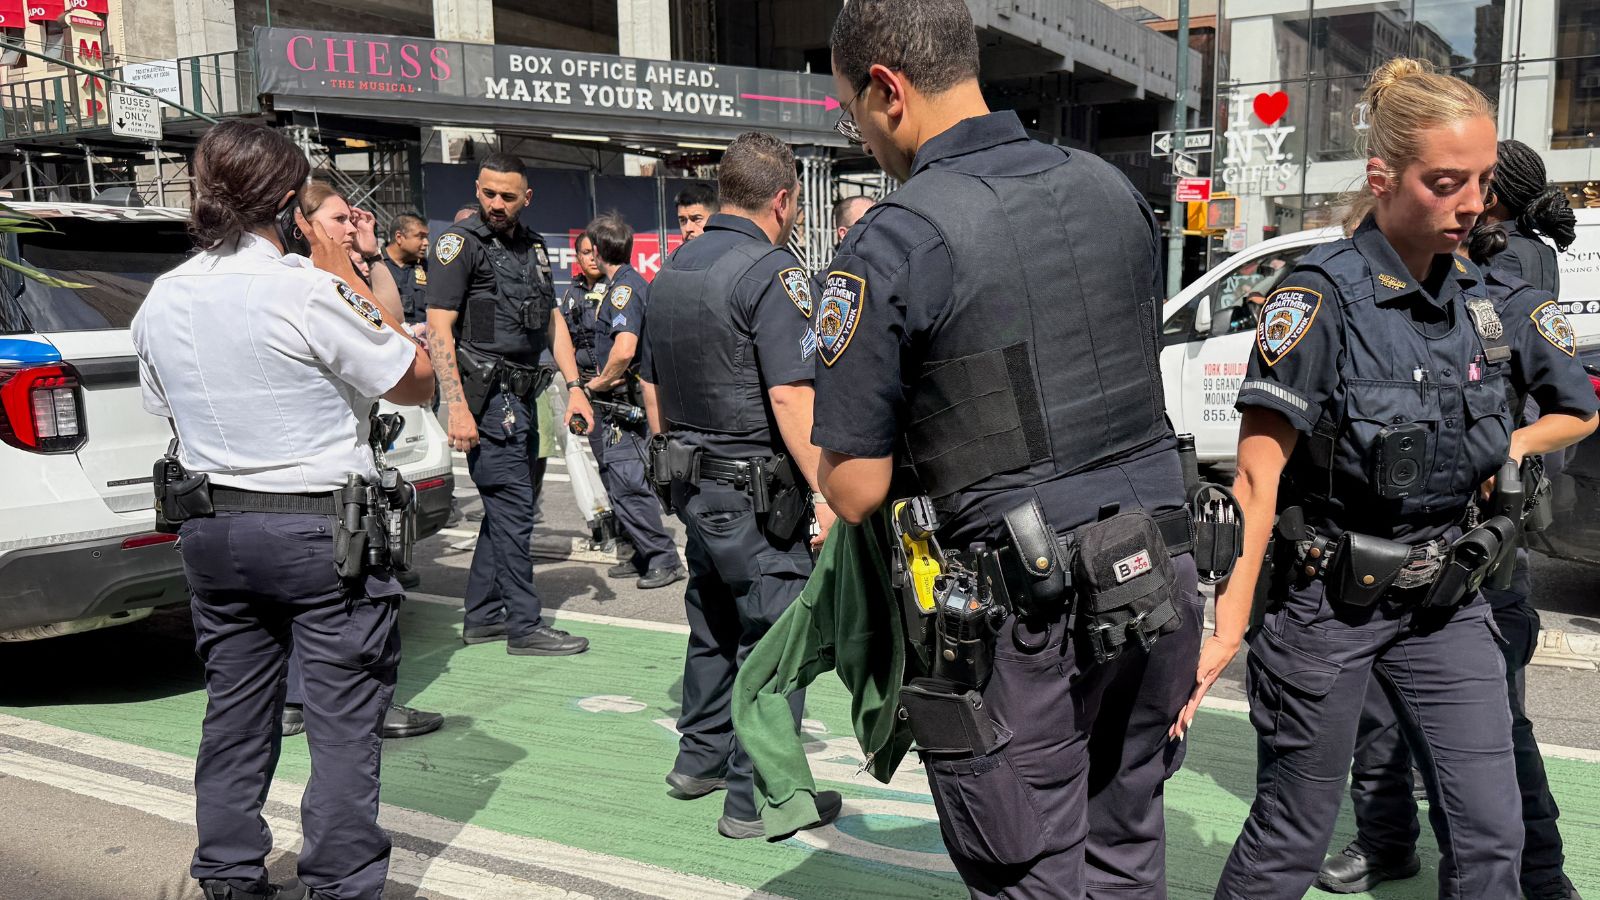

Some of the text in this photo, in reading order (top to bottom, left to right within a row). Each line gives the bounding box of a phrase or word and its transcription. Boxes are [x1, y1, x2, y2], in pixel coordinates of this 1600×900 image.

[286, 35, 451, 81] CHESS
[509, 54, 720, 89] BOX OFFICE AHEAD.
[330, 79, 415, 94] THE MUSICAL
[120, 96, 150, 108] BUSES
[484, 76, 742, 117] MAKE YOUR MOVE.
[125, 111, 148, 122] ONLY
[1187, 137, 1206, 147] WAY
[1222, 163, 1292, 184] GIFTS
[1275, 292, 1305, 302] POLICE
[1265, 300, 1312, 313] DEPARTMENT
[832, 308, 857, 354] NEW YORK
[1276, 316, 1310, 356] NEW YORK
[1203, 363, 1221, 376] YORK
[1203, 378, 1241, 391] 99 GRAND
[1204, 392, 1239, 405] MOONAC
[1119, 564, 1131, 578] B
[1133, 562, 1147, 572] POS
